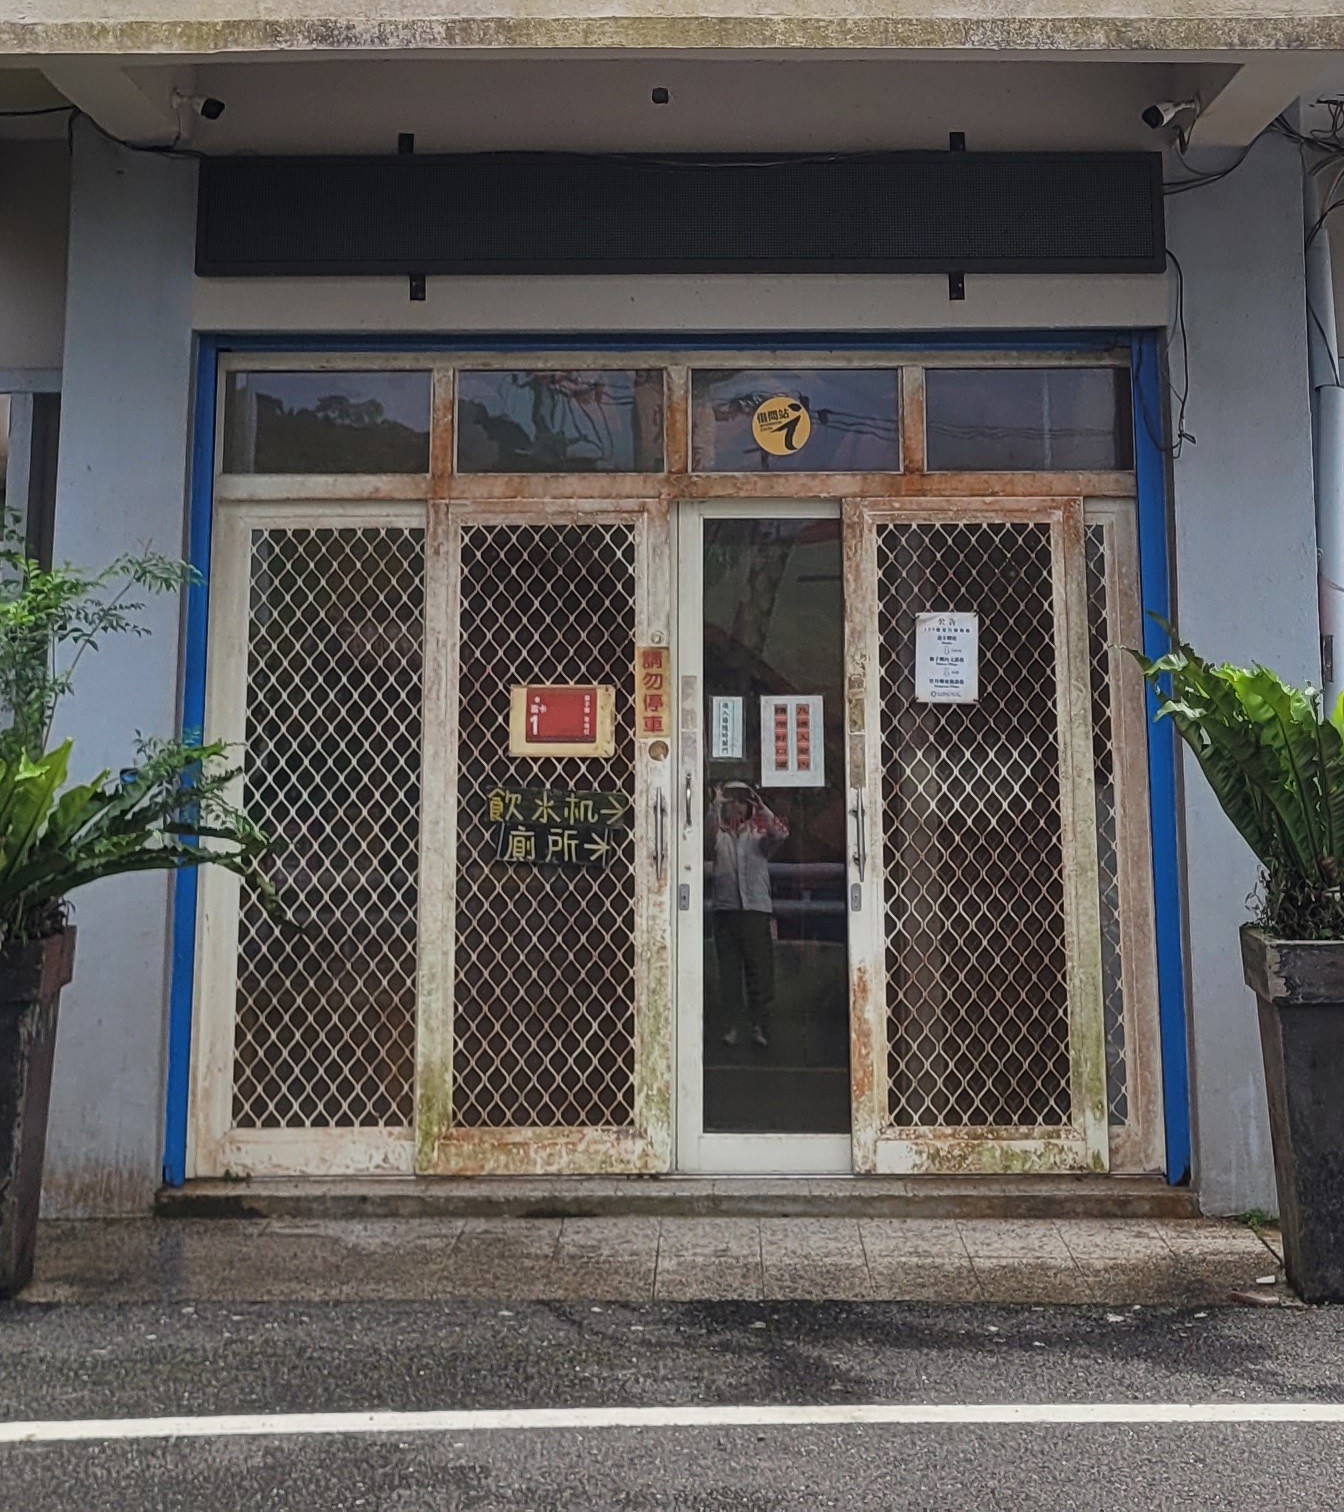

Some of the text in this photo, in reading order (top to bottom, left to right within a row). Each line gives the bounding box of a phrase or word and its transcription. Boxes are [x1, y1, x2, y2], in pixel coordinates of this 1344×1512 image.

[757, 408, 790, 425] 借問站
[642, 649, 665, 734] 請勿停車
[529, 715, 538, 735] 1
[506, 826, 578, 863] 廁所
